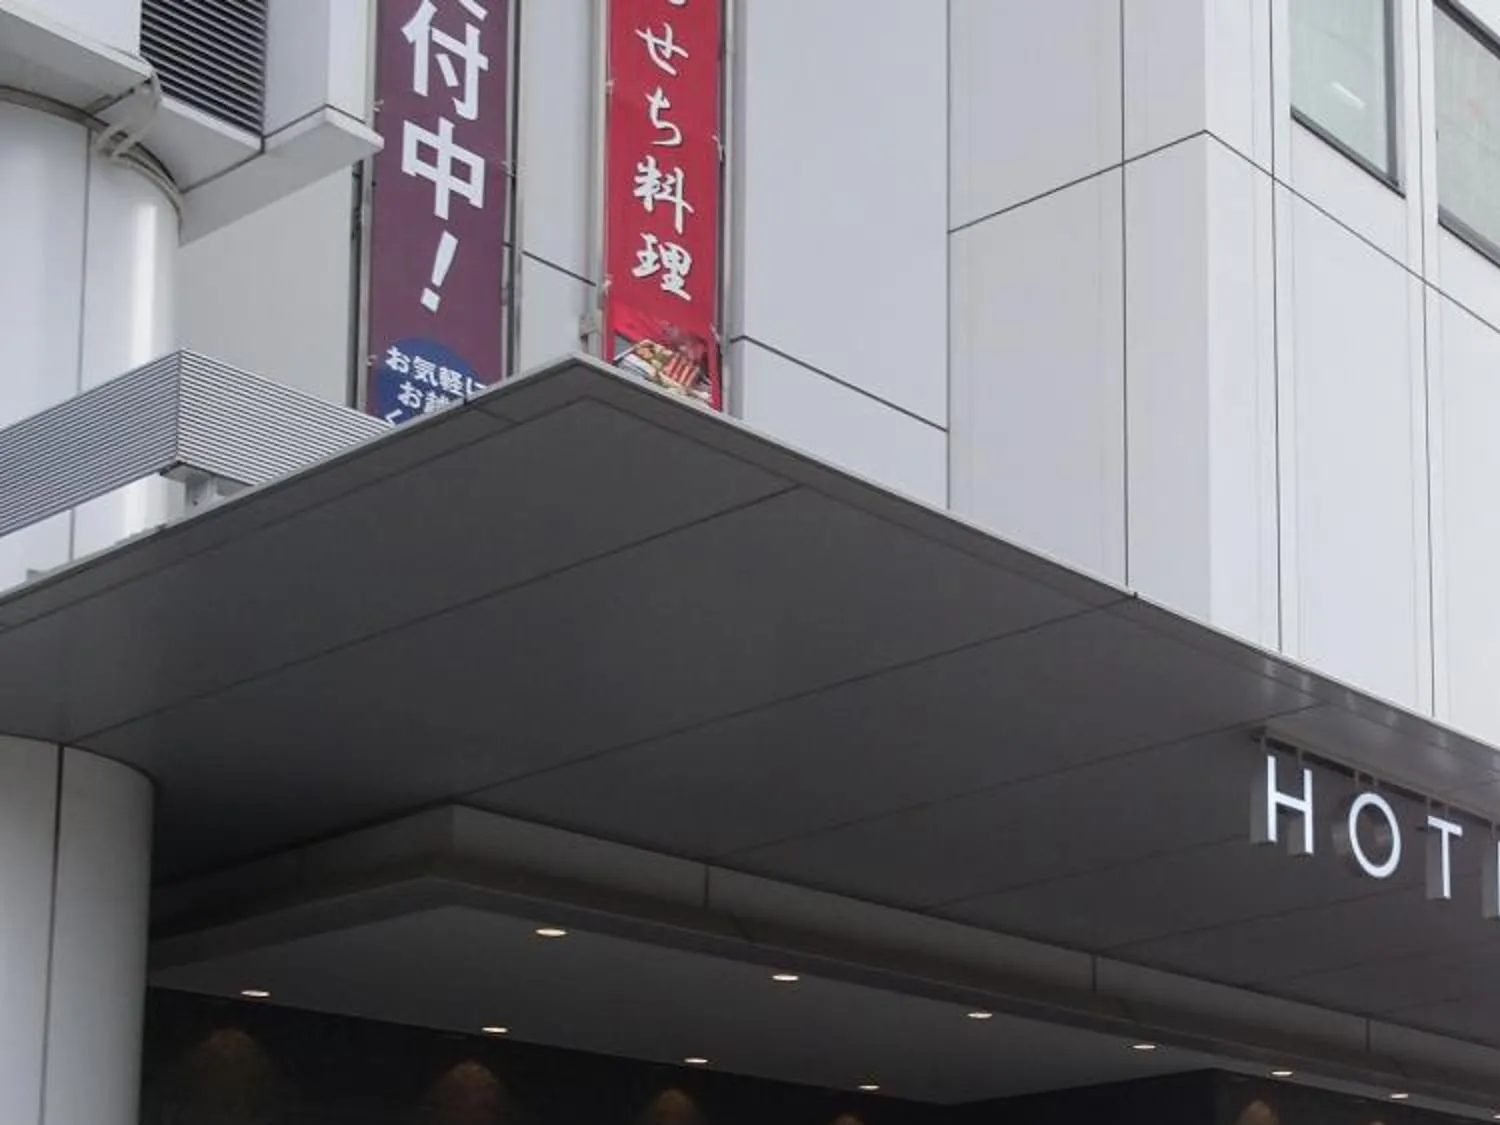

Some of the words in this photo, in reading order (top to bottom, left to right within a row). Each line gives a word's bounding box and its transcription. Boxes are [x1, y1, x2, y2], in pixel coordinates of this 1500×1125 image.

[401, 0, 489, 313] 付中！
[632, 0, 694, 301] せち料理
